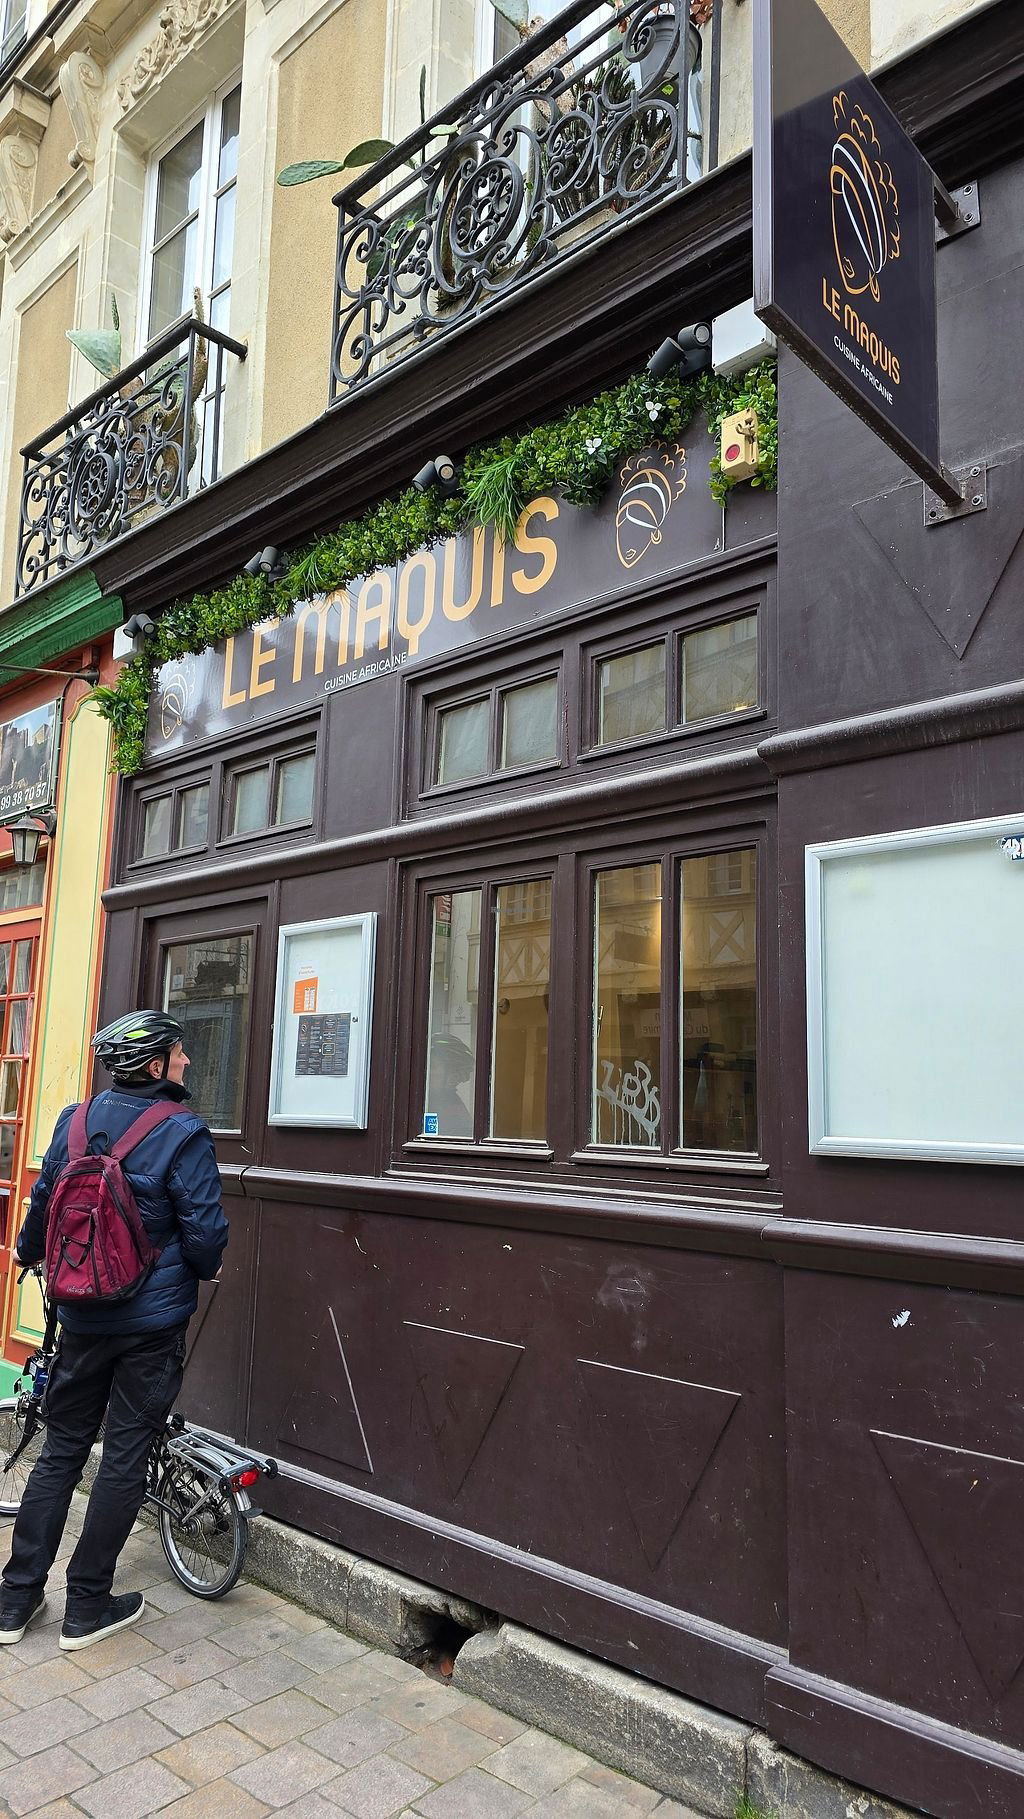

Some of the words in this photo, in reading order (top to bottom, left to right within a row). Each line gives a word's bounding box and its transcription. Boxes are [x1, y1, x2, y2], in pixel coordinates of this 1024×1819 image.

[822, 277, 841, 321] LE
[844, 303, 900, 384] MAQUIS
[833, 335, 860, 370] CUISINE
[860, 364, 893, 405] AFRICAINE
[222, 616, 280, 710] LE
[292, 496, 560, 684] MAQUIS
[324, 669, 358, 691] CUISINE
[358, 651, 407, 679] AFRICAINE
[11, 790, 23, 807] 38
[24, 786, 35, 802] 70
[35, 781, 47, 798] 57
